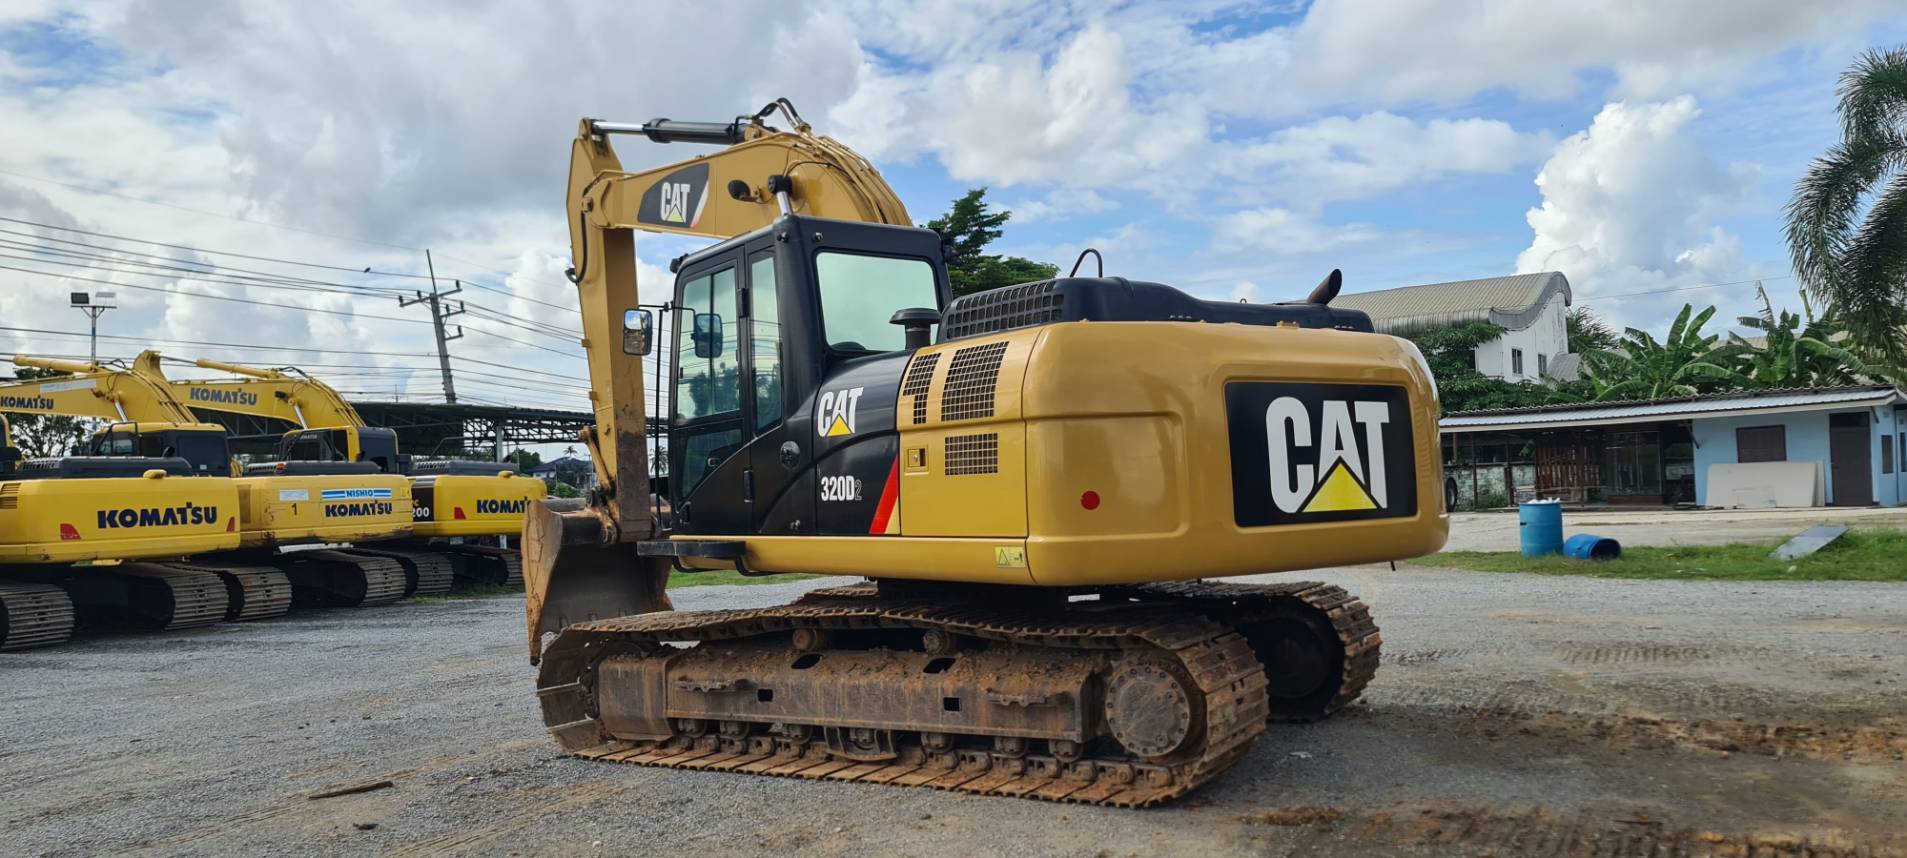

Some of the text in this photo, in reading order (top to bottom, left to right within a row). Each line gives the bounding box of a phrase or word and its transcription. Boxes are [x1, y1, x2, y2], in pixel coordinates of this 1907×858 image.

[661, 182, 691, 223] CAT
[0, 395, 54, 409] KOMATSU
[190, 387, 257, 405] KOMATSU
[818, 387, 864, 437] CAT
[1266, 396, 1390, 514] CAT
[346, 489, 373, 497] NISHIO
[821, 475, 862, 502] 320D2
[97, 502, 217, 529] KOMATSU
[325, 500, 392, 517] KOMATSU
[477, 496, 530, 513] KOMAT
